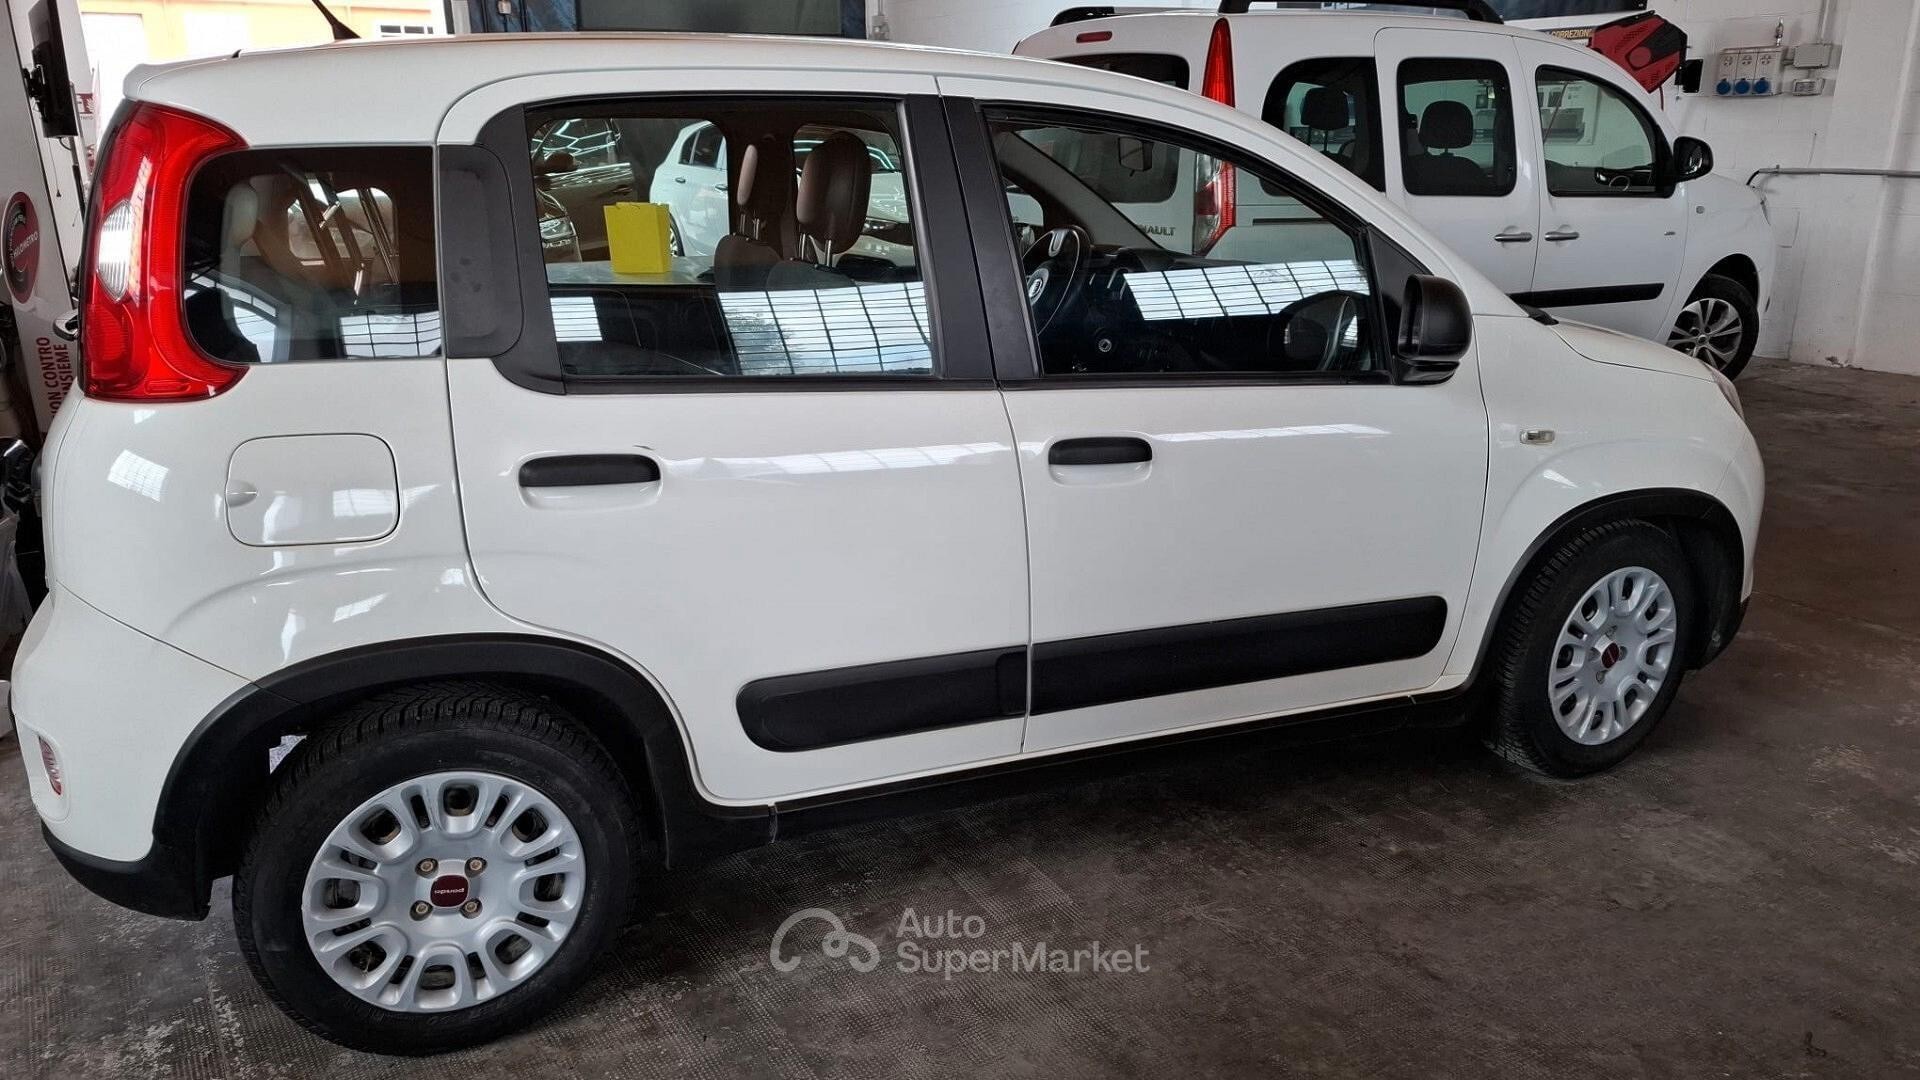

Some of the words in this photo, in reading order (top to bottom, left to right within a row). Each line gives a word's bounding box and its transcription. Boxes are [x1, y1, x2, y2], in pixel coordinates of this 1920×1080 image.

[1137, 224, 1176, 236] NAULT
[36, 337, 60, 388] CONTRO
[53, 344, 74, 395] NSIEME
